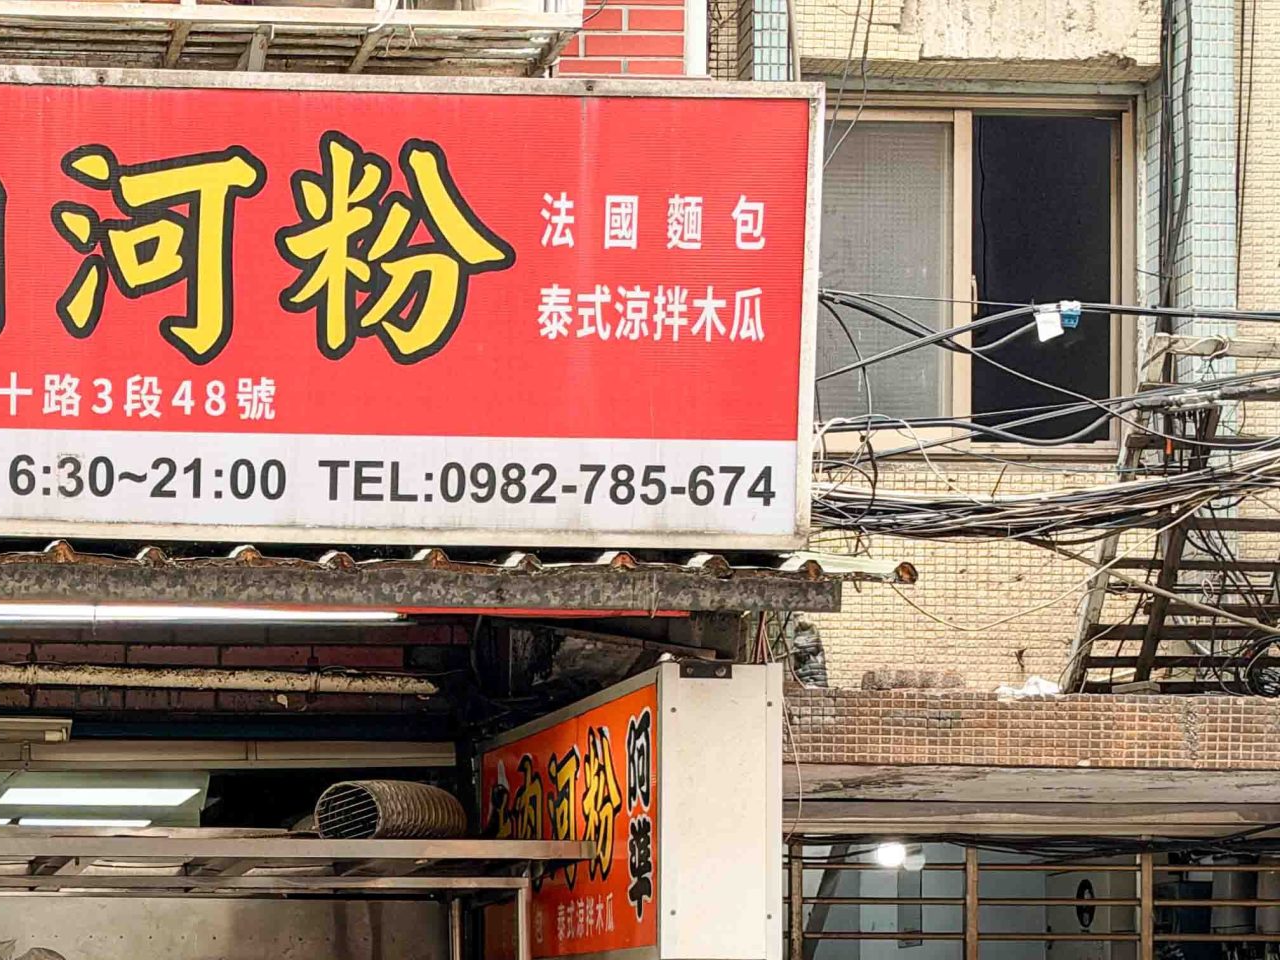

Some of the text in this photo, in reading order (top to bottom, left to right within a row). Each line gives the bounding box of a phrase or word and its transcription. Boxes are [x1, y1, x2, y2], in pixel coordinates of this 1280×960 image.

[540, 193, 767, 251] 法國麵包
[537, 285, 766, 345] 泰式涼拌木瓜
